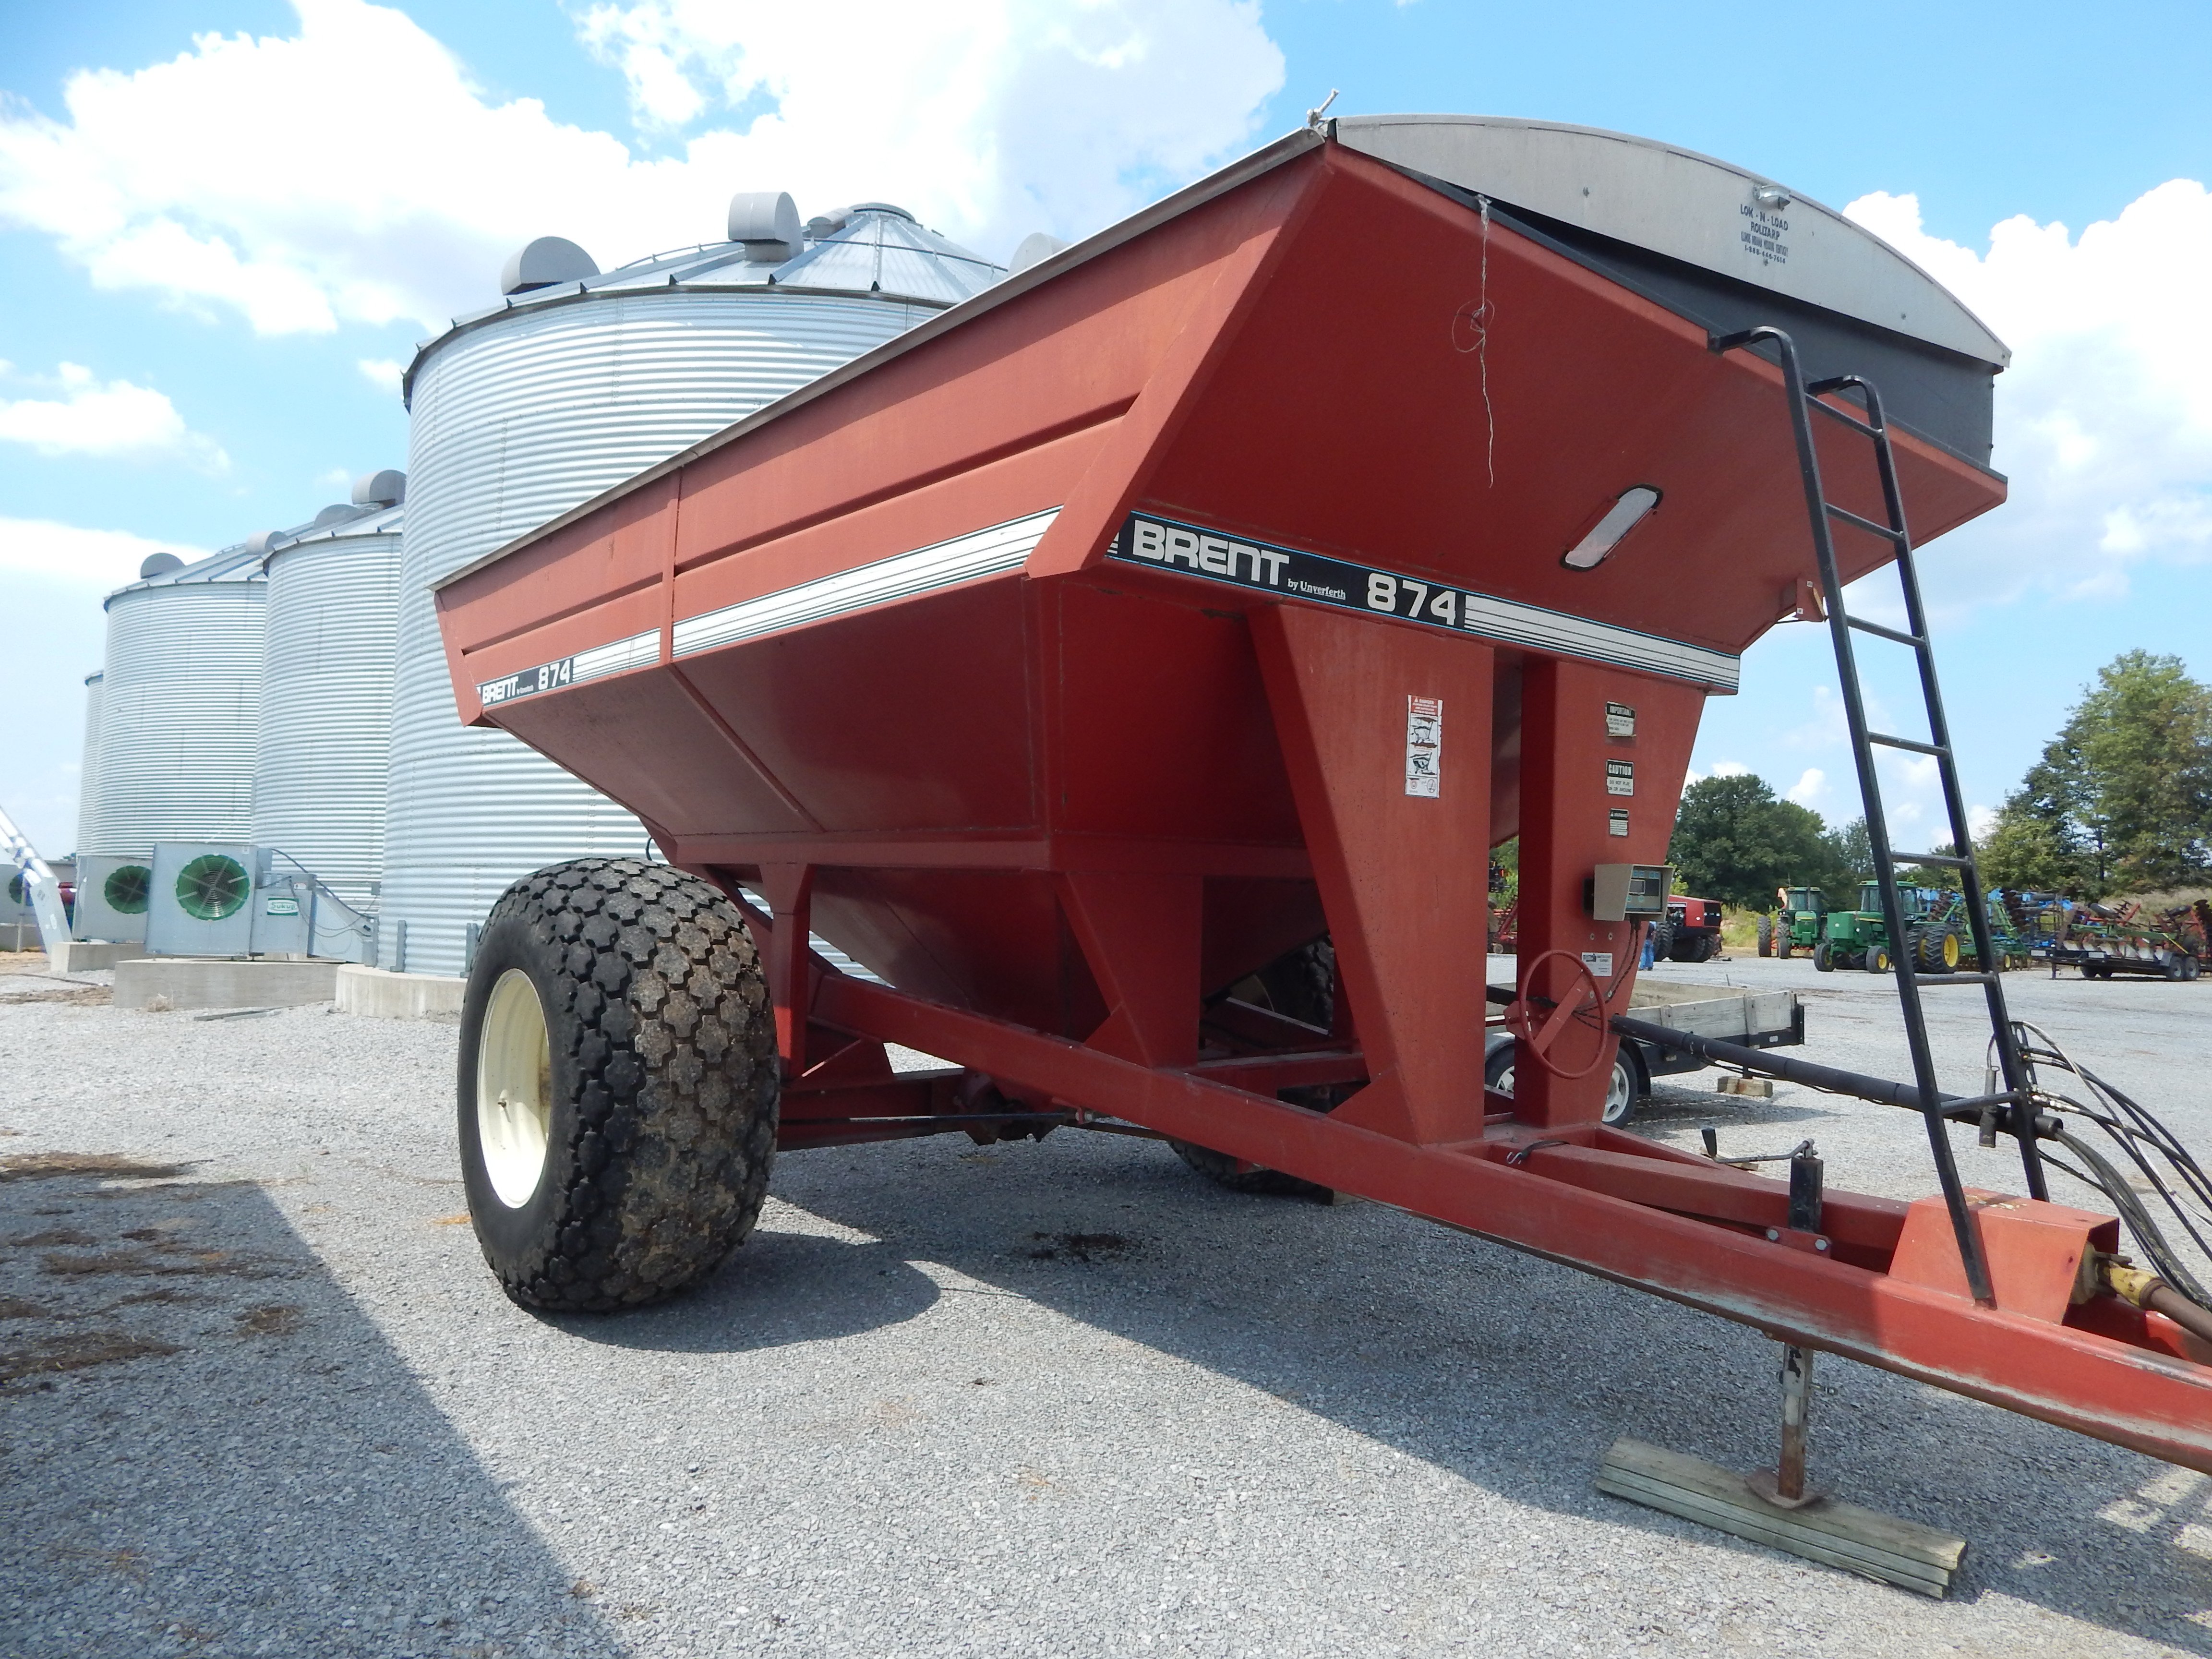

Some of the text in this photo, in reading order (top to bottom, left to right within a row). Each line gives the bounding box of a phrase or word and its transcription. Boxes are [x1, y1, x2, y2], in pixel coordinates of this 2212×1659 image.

[1740, 204, 1753, 218] LOK
[1760, 211, 1766, 223] N
[1771, 216, 1789, 231] LOAD
[1132, 519, 1456, 626] BRENT by Unverferth 874
[482, 659, 571, 704] BRENT 874
[1608, 764, 1632, 776] CAUTION
